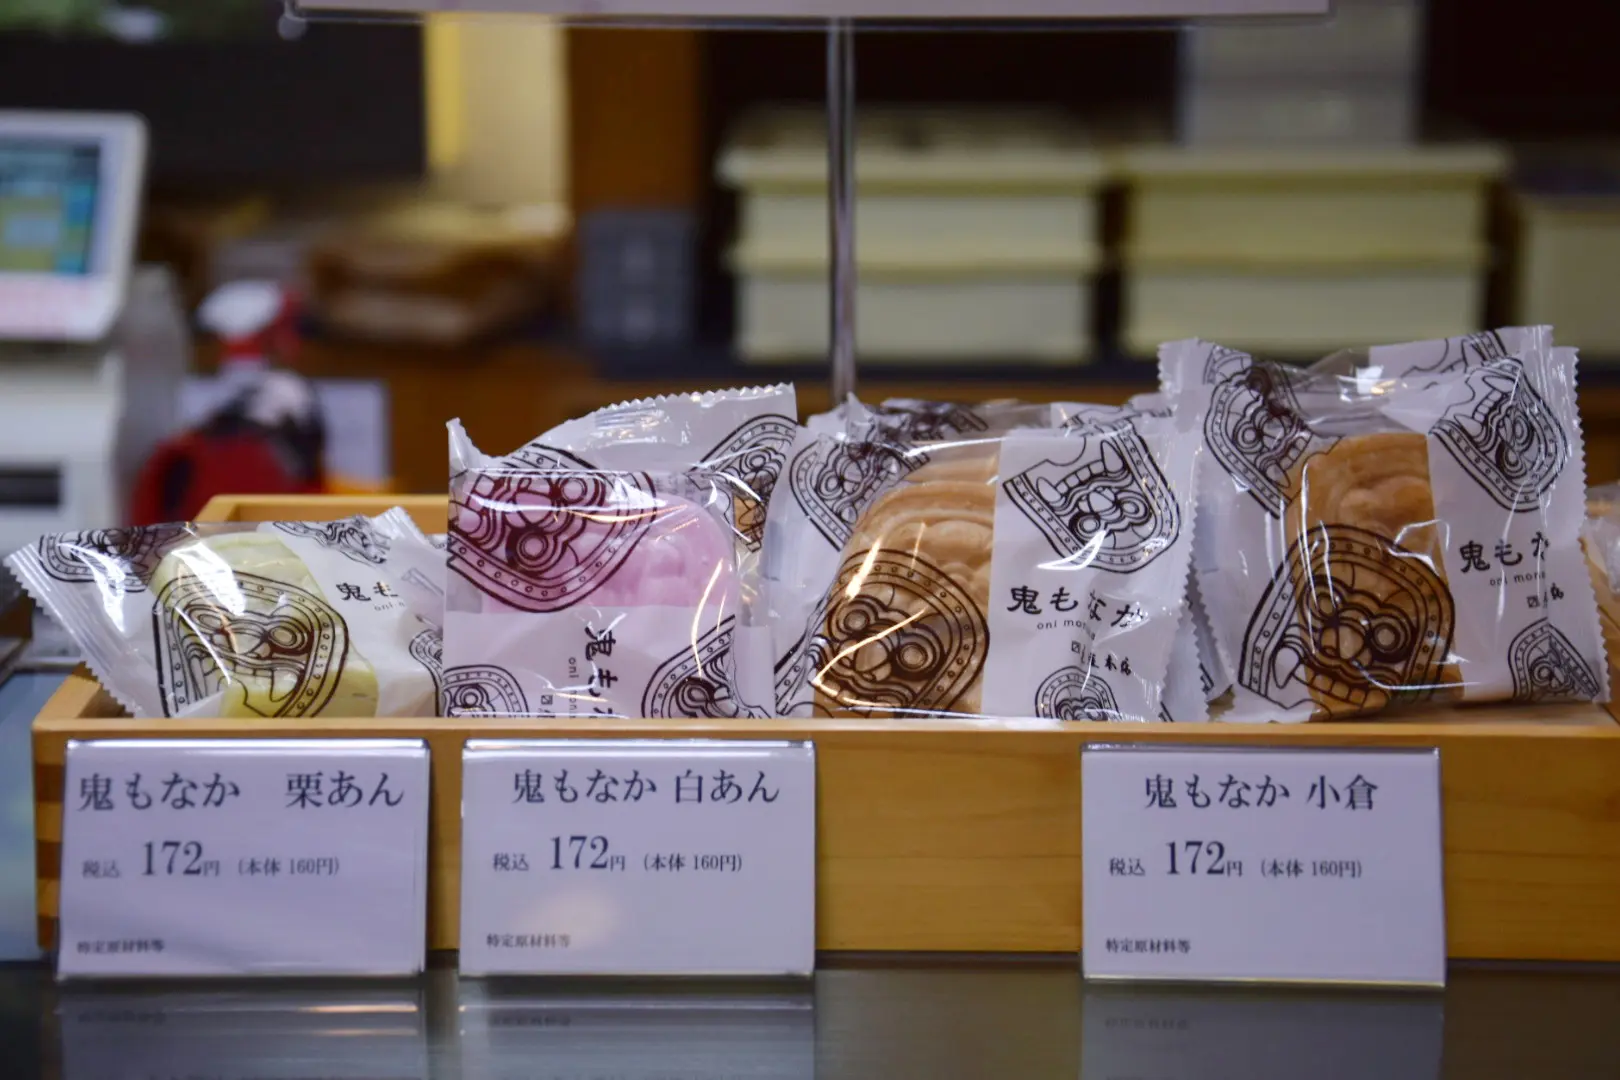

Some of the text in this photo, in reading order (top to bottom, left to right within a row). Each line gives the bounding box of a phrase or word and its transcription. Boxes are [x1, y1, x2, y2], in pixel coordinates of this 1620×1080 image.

[1037, 619, 1058, 630] oni
[568, 657, 579, 679] oni
[77, 771, 404, 811] 鬼もなか 栗あん
[512, 769, 780, 804] 鬼もなか 白あん
[1145, 774, 1379, 811] 鬼もなか 小倉
[82, 860, 120, 879] 税込
[141, 840, 220, 877] 172円
[493, 853, 529, 872] 税込
[550, 835, 626, 872] 172円
[1109, 857, 1146, 877] 税込
[1165, 840, 1243, 877] 172円
[486, 933, 571, 948] 特定原材料等
[1105, 938, 1191, 954] 特定原材料等
